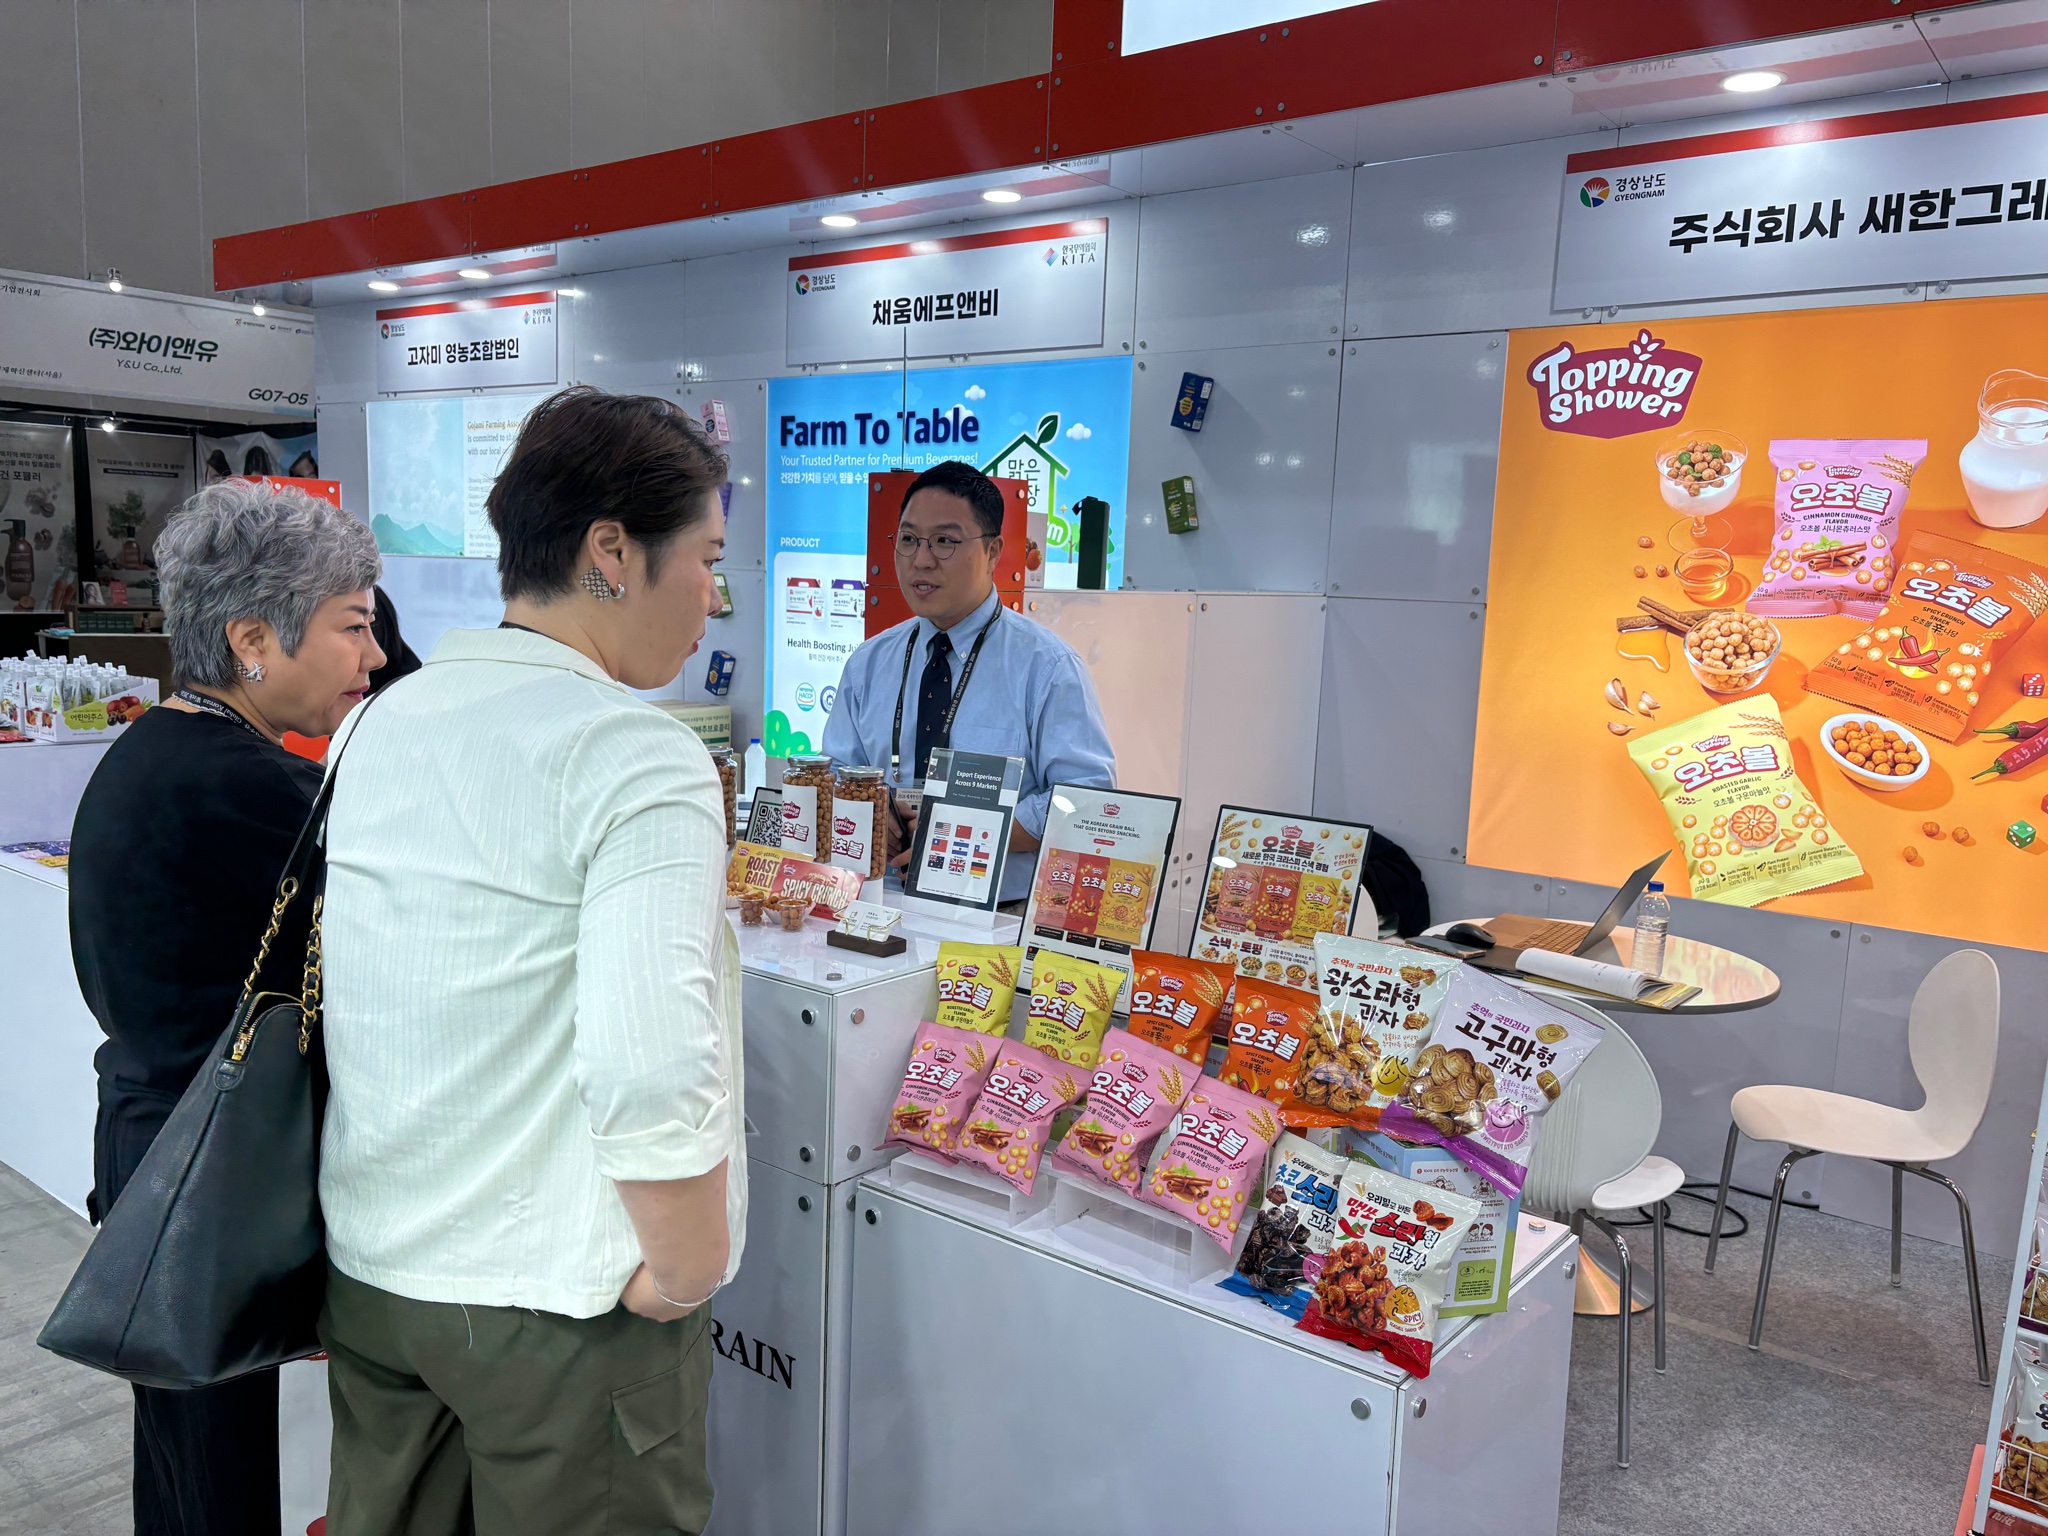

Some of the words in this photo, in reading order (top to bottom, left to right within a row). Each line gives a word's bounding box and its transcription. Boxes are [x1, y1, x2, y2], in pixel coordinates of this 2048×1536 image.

[1615, 173, 1666, 192] 경상남도
[1614, 189, 1665, 202] GYEONGNAM
[1669, 199, 1844, 254] 주식회사
[1061, 253, 1096, 265] KITA
[812, 274, 836, 285] 경상남도
[872, 289, 998, 326] 채움에프앤비
[532, 315, 551, 325] KITA
[89, 327, 219, 363] (주)와이앤유
[407, 345, 441, 365] 고자미
[446, 338, 519, 363] 영농조합법인
[116, 358, 141, 370] Y&U
[1533, 346, 1693, 397] Topping
[249, 387, 309, 405] G07-05
[1549, 390, 1682, 423] Shower
[486, 419, 505, 430] Farming
[780, 416, 846, 446] Farm
[854, 413, 889, 445] To
[897, 408, 979, 443] Table
[473, 433, 499, 443] committed
[468, 447, 478, 455] with
[489, 447, 500, 455] local
[780, 455, 799, 466] Your
[801, 454, 832, 466] Trusted
[834, 454, 866, 466] Partner
[868, 453, 880, 465] for
[780, 472, 800, 484] 건강한
[801, 472, 821, 484] 가치를
[1791, 481, 1892, 516] 오초볼
[1803, 512, 1840, 521] CINNAMON
[1841, 512, 1873, 522] CHURROS
[1800, 524, 1820, 533] 오초볼
[780, 537, 820, 548] PRODUCT
[1900, 578, 2012, 629] 오초볼
[1910, 616, 1932, 628] 오초볼
[1923, 606, 1941, 616] SPICY
[1941, 611, 1966, 626] CRUNCH
[1929, 615, 1951, 626] SNACK
[787, 638, 811, 650] Health
[813, 639, 846, 653] Boosting
[956, 770, 974, 780] Export
[974, 773, 1001, 782] Experience
[1674, 744, 1779, 793] 오초볼
[954, 780, 972, 788] Across
[976, 782, 998, 790] Markets
[1712, 780, 1738, 793] ROASTED
[1739, 776, 1762, 786] GARLIC
[1727, 784, 1750, 794] FLAVOR
[1713, 796, 1735, 808] 오초볼
[1735, 786, 1771, 801] 구운마늘맛
[781, 822, 809, 842] 초볼
[1098, 827, 1116, 835] BEYOND
[1116, 831, 1141, 839] SNACKING.
[1262, 836, 1315, 859] 오초볼
[1241, 851, 1261, 860] 새로운
[1262, 853, 1275, 862] 한국
[1276, 855, 1300, 866] 크리스피
[1301, 859, 1314, 869] 스낵
[1315, 862, 1329, 872] 경험
[781, 879, 813, 900] SPICY
[811, 885, 849, 909] CRUNCH
[1113, 882, 1141, 897] 오초볼
[1209, 935, 1232, 949] 스낵
[1240, 941, 1263, 956] 토핑
[1331, 957, 1354, 968] 추억의
[1356, 963, 1393, 975] 국민과자
[938, 979, 993, 1011] 오초볼
[1323, 968, 1421, 1011] 왕소라형
[1029, 994, 1086, 1032] 오초볼
[1131, 990, 1199, 1029] 오초볼
[1359, 1002, 1399, 1029] 과자
[1471, 1002, 1493, 1018] 추억의
[1495, 1013, 1530, 1034] 국민과자
[1230, 1022, 1301, 1063] 오초볼
[1455, 1011, 1557, 1068] 고구마형
[904, 1061, 963, 1091] 오초볼
[1487, 1052, 1532, 1081] 과자
[983, 1074, 1050, 1115] 오초볼
[1088, 1071, 1154, 1119] 오초볼
[1089, 1097, 1114, 1109] CINNAMON
[999, 1108, 1013, 1117] FLAVOR
[1101, 1106, 1116, 1117] FLAVOR
[1177, 1113, 1248, 1161] 오초볼
[1177, 1141, 1204, 1152] CINNAMON
[1204, 1149, 1225, 1164] CHURROS
[1190, 1150, 1208, 1160] FLAVOR
[1292, 1157, 1317, 1173] 우리밀로
[1366, 1192, 1396, 1210] 우리밀로
[1397, 1204, 1412, 1215] 만든
[1370, 1212, 1440, 1249] 소라형
[1389, 1242, 1427, 1271] 과자
[1404, 1312, 1421, 1322] SPICY
